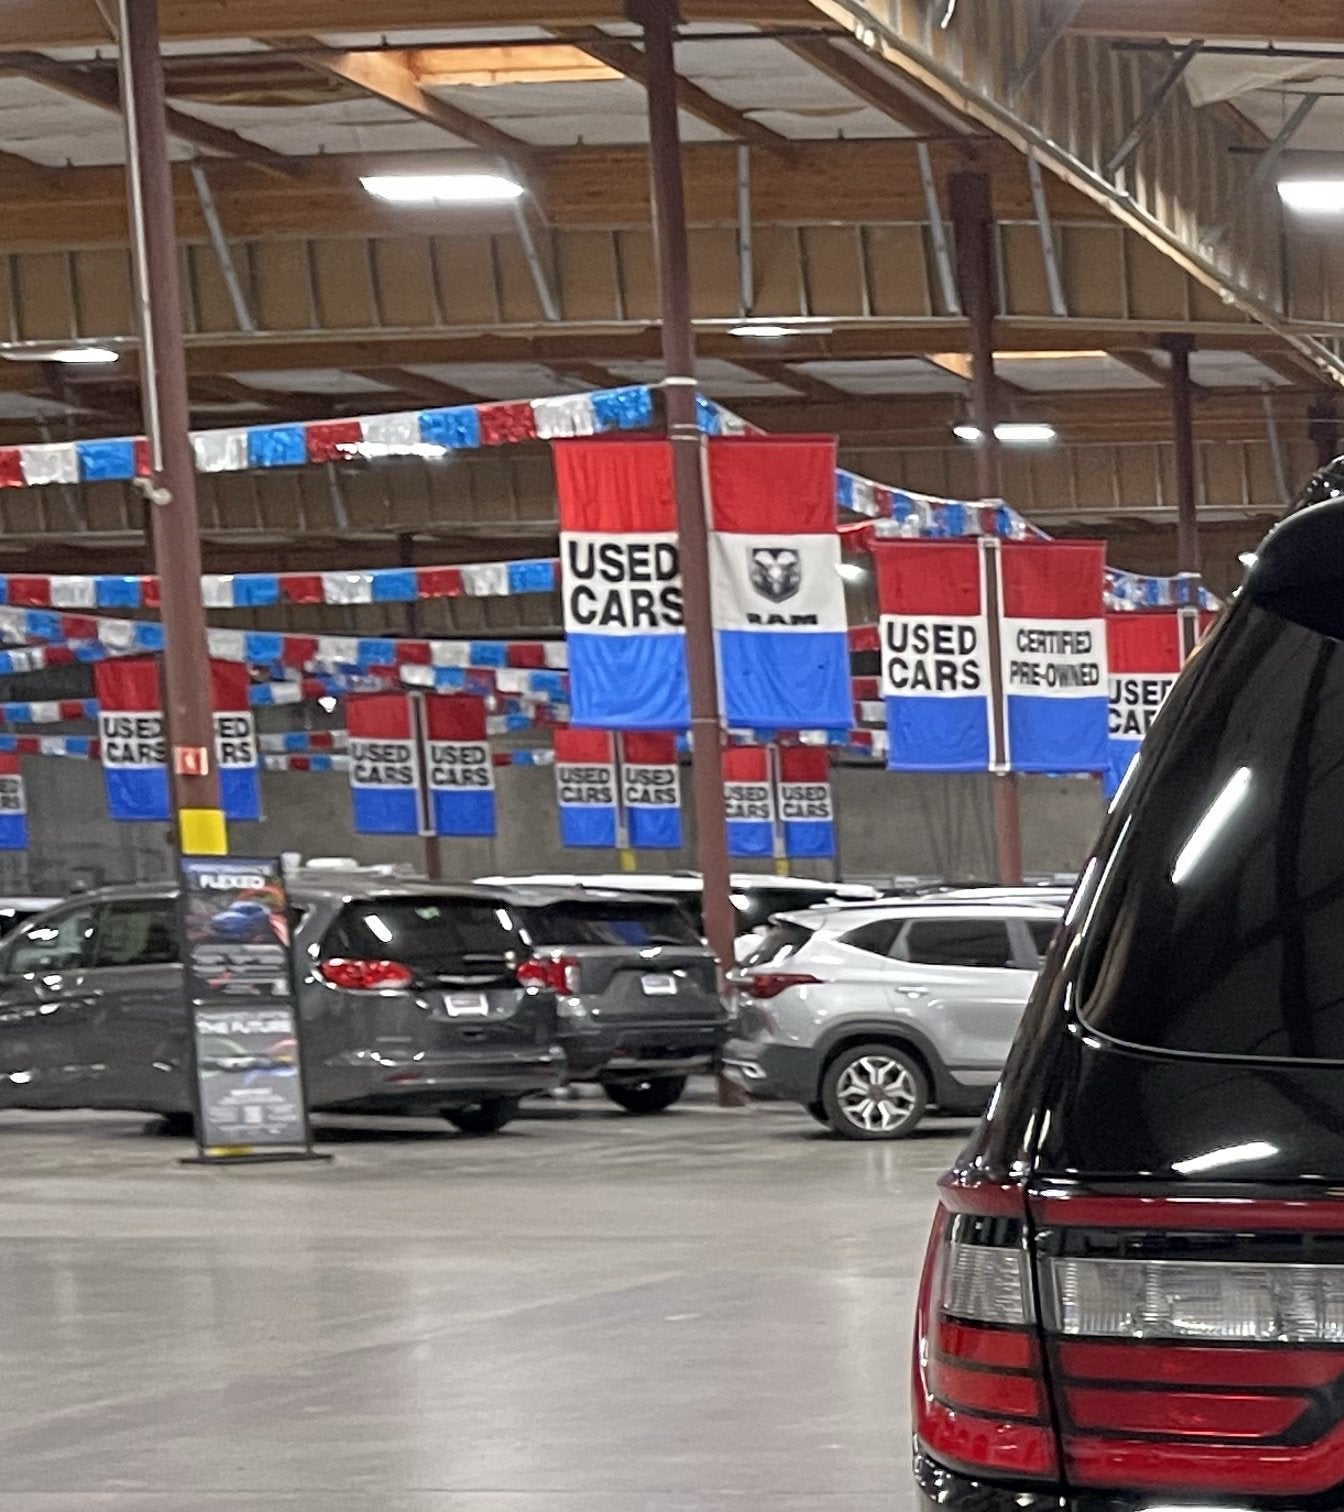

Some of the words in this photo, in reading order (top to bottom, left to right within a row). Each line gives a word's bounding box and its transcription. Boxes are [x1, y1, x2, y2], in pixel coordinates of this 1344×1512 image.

[569, 541, 679, 582] USED
[570, 585, 684, 627] CARS
[747, 613, 818, 625] RAM
[887, 622, 977, 655] USED
[1016, 628, 1092, 654] CERTIFIED
[888, 657, 981, 691] CARS
[1009, 661, 1099, 687] PRE-OWNED
[104, 717, 162, 738] USED
[218, 717, 250, 738] ED
[1108, 707, 1158, 735] CA
[106, 742, 166, 763] CARS
[221, 742, 251, 763] RS
[352, 743, 410, 762] USED
[431, 745, 486, 764] USED
[354, 765, 413, 784] CARS
[432, 767, 489, 786] CARS
[560, 767, 610, 784] USED
[626, 768, 675, 785] USED
[561, 787, 612, 803] CARS
[627, 787, 676, 803] CARS
[724, 786, 767, 801] SED
[782, 786, 827, 801] USED
[783, 803, 828, 818] CARS
